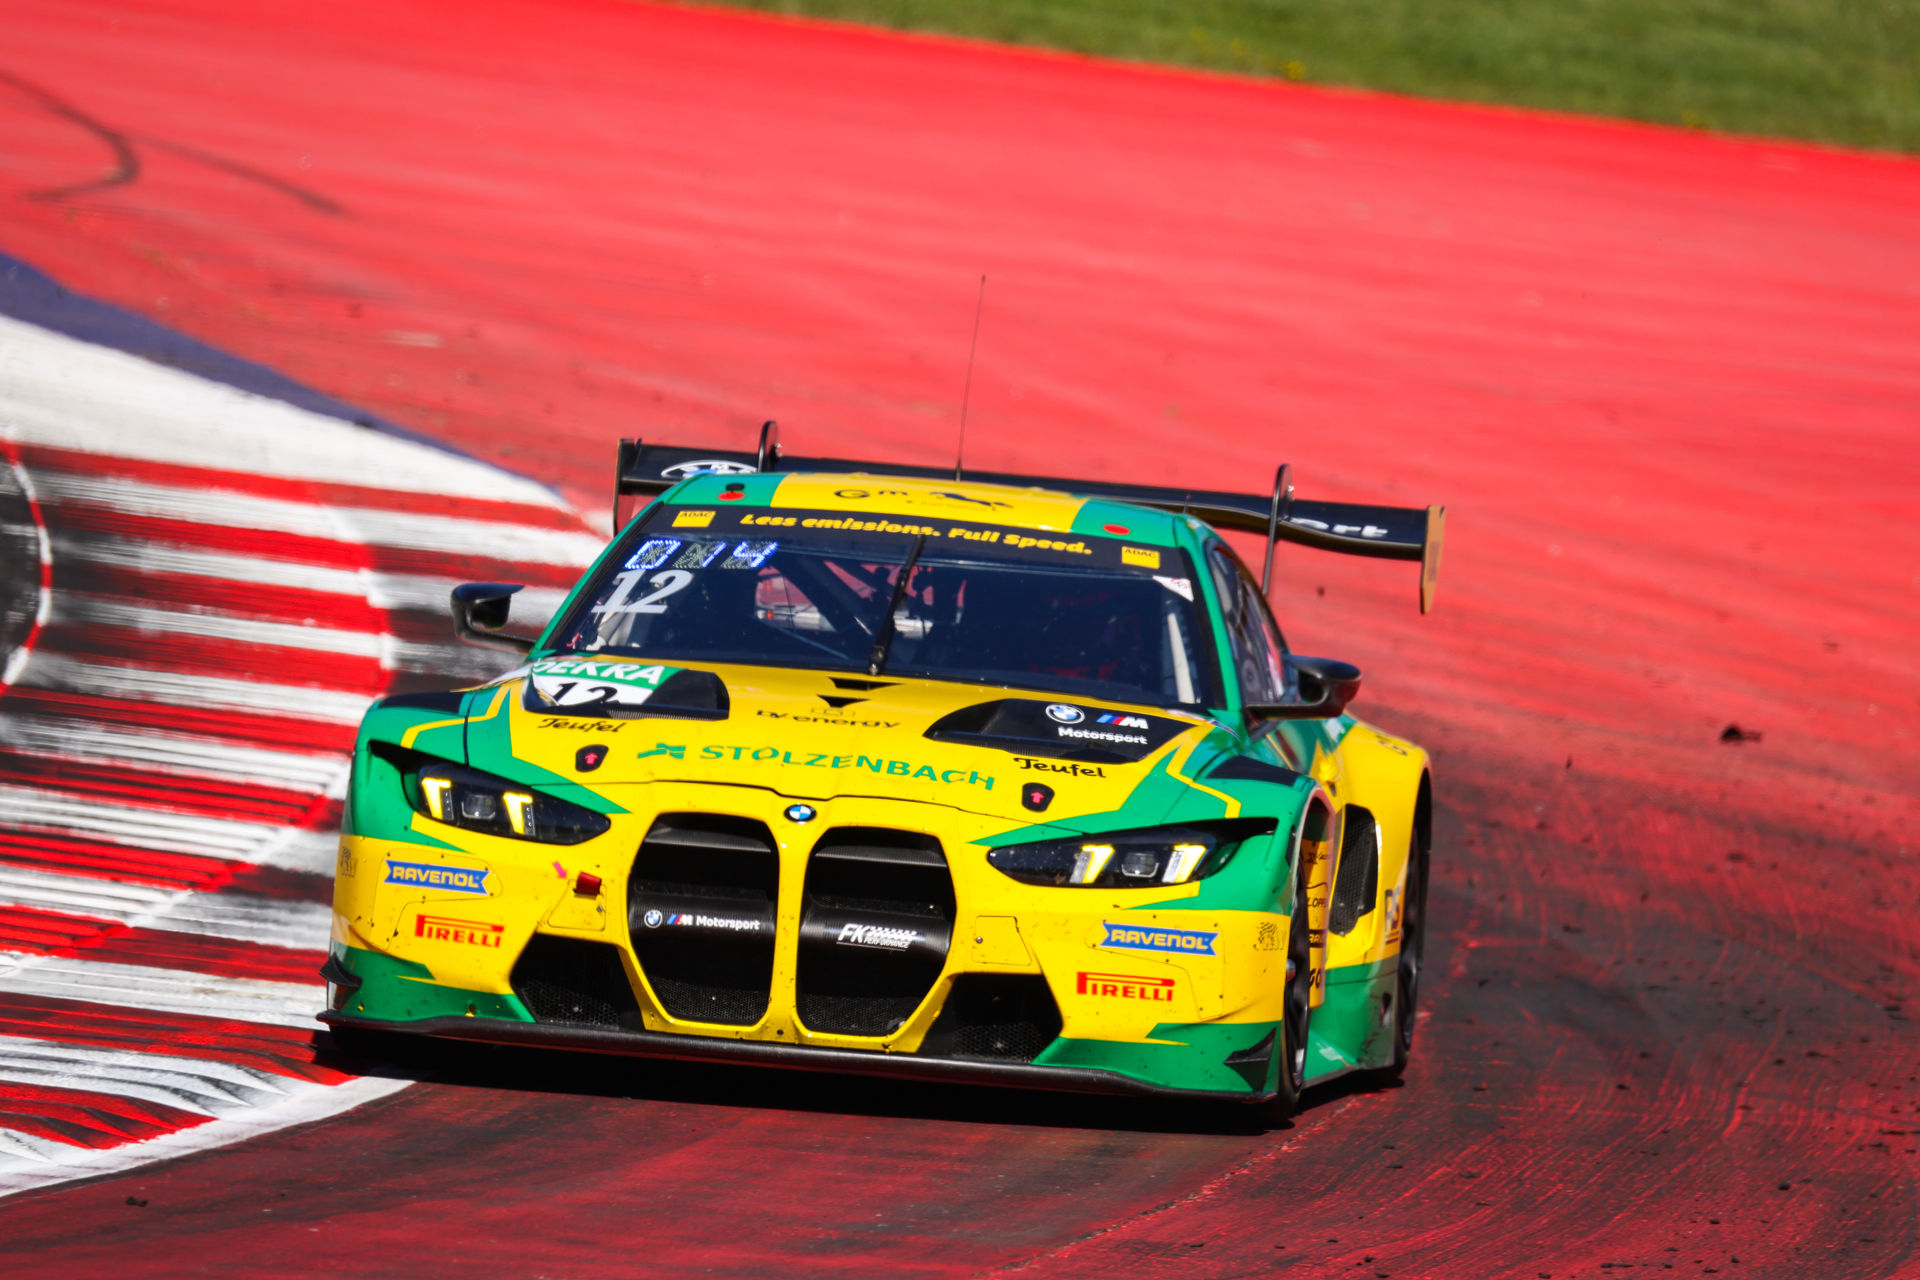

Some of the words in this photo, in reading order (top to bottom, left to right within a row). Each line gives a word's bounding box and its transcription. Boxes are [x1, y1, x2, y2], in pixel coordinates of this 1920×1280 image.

[739, 513, 798, 527] Less
[801, 518, 941, 537] emissions.
[948, 528, 1000, 543] Full
[1003, 534, 1093, 555] Speed.
[591, 569, 694, 614] 12
[538, 718, 627, 733] Teufel
[1058, 726, 1148, 745] Motorsport
[700, 745, 995, 791] STOLZENBACH
[1013, 757, 1106, 778] Teufel
[392, 866, 479, 888] RAVENOL
[414, 914, 505, 948] PIRELLI
[696, 915, 760, 931] Motorsport
[838, 922, 871, 943] FK
[1109, 929, 1209, 950] RAVENOL
[1076, 971, 1175, 1002] PIRELLI
